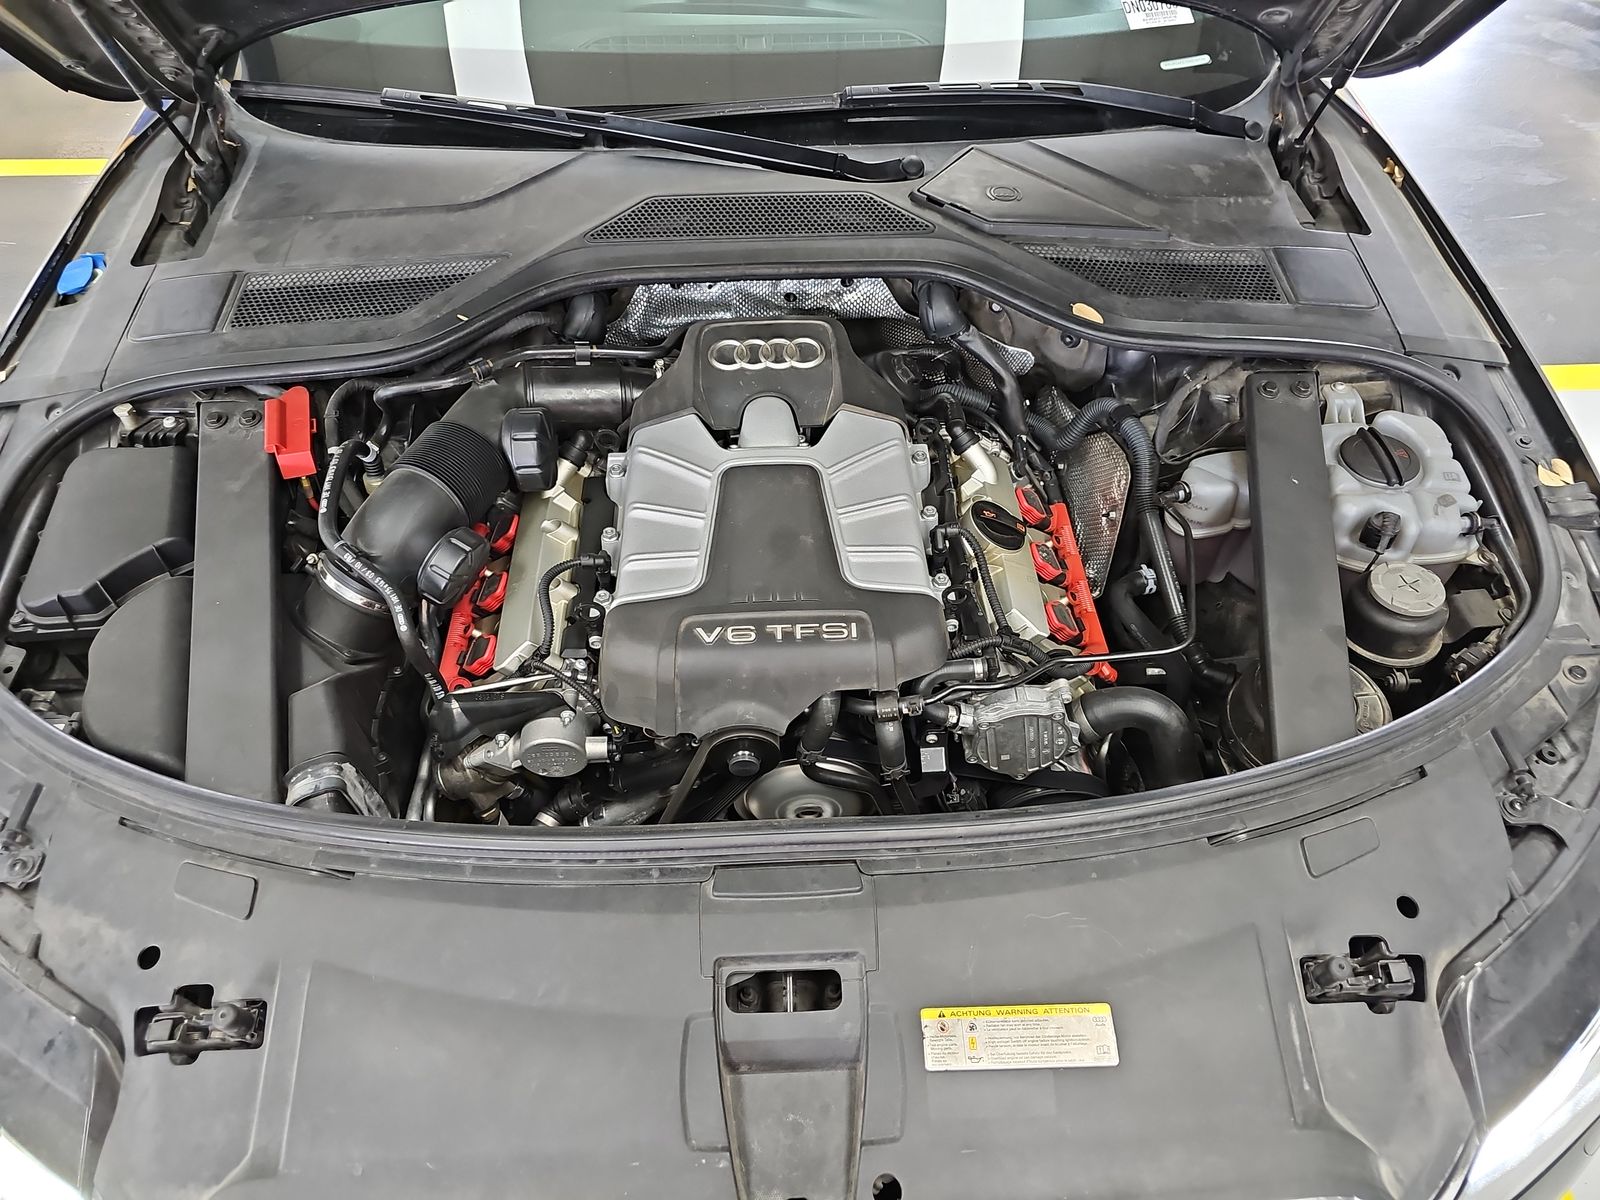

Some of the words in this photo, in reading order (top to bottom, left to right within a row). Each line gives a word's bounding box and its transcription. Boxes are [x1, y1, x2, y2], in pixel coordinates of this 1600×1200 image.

[693, 625, 757, 645] V6
[765, 622, 859, 642] TFSI
[950, 1009, 992, 1018] ACHTUNG
[995, 1008, 1039, 1016] WARNING
[1043, 1007, 1091, 1015] ATTENTION
